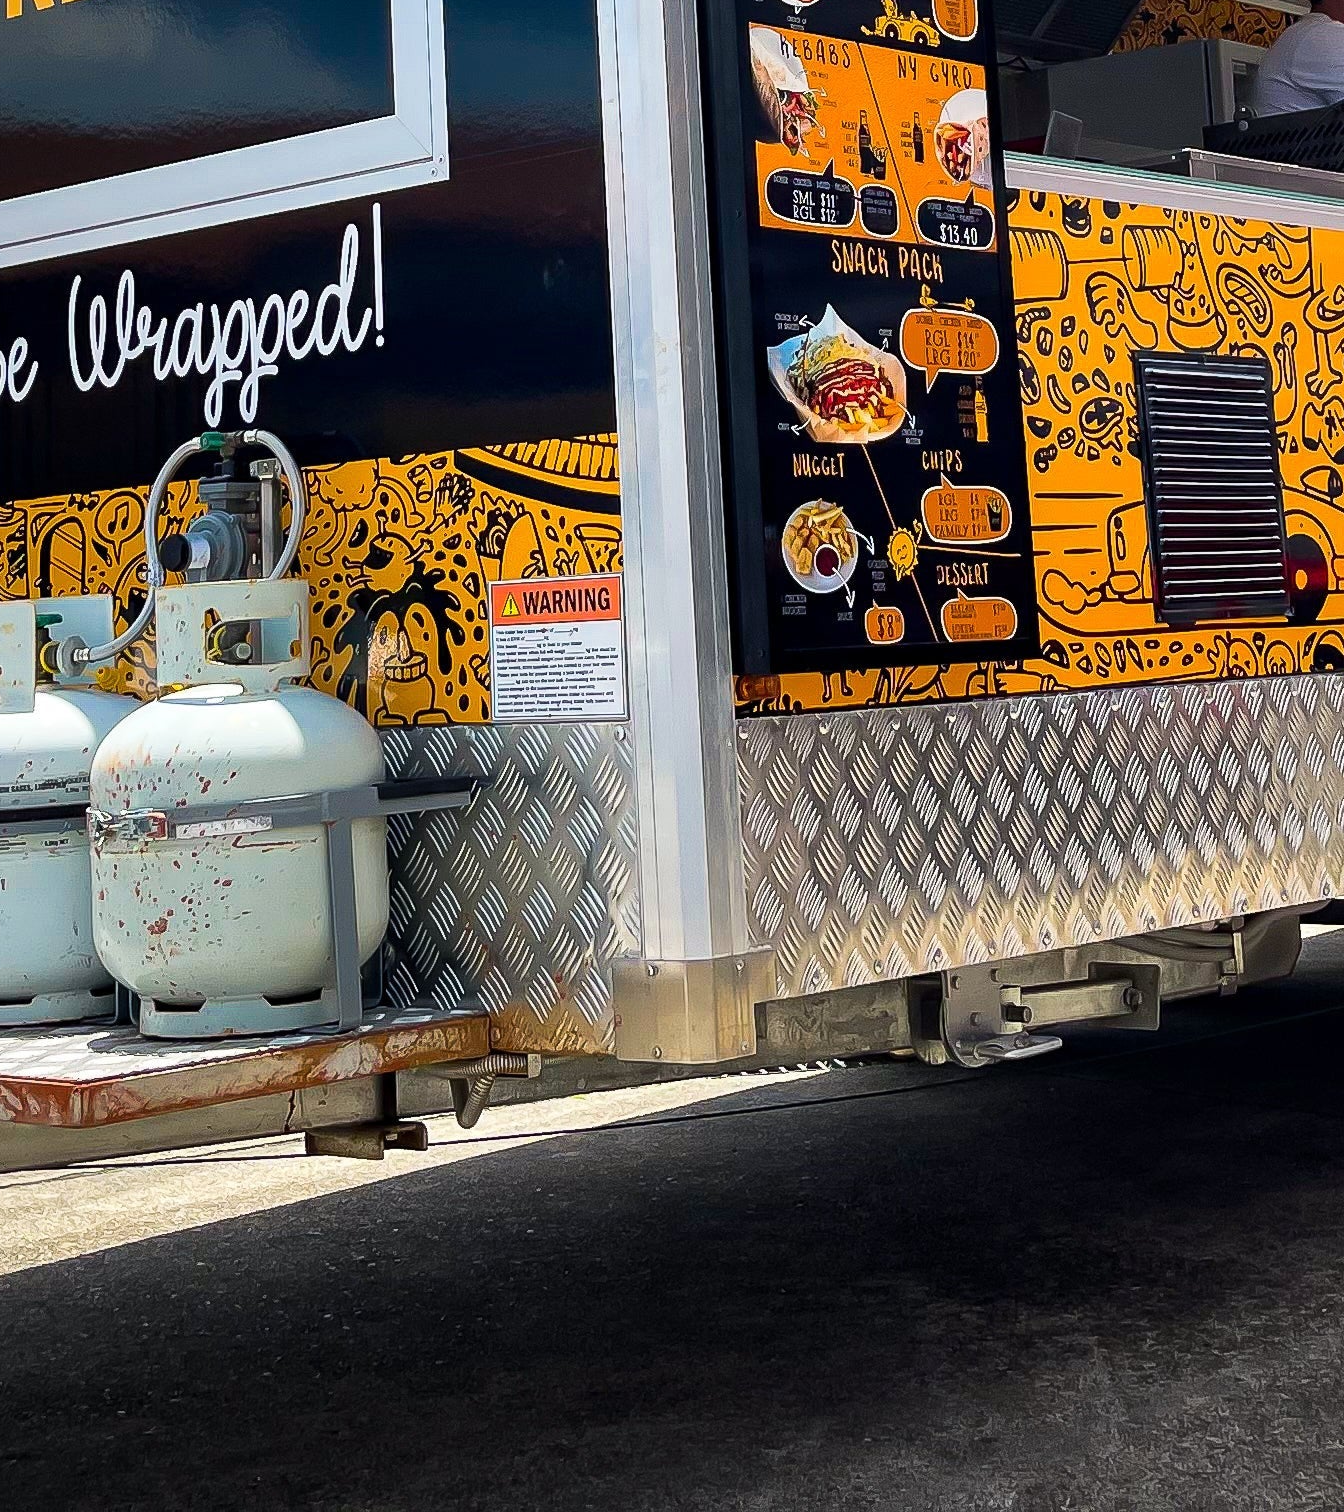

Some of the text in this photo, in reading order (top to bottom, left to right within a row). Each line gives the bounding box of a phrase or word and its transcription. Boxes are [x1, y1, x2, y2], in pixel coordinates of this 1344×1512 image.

[780, 33, 851, 69] KEBABS
[897, 54, 972, 90] NY GYRO
[792, 189, 816, 206] SML
[792, 204, 816, 221] RGL
[939, 222, 978, 245] $13.40
[830, 239, 944, 283] SNACK PACK
[68, 202, 386, 428] Wrapped!
[925, 329, 951, 347] RGL
[926, 347, 951, 366] LRG
[793, 449, 963, 478] NUGGET CHIPS
[936, 562, 989, 586] DESSERT
[523, 587, 611, 616] WARNING
